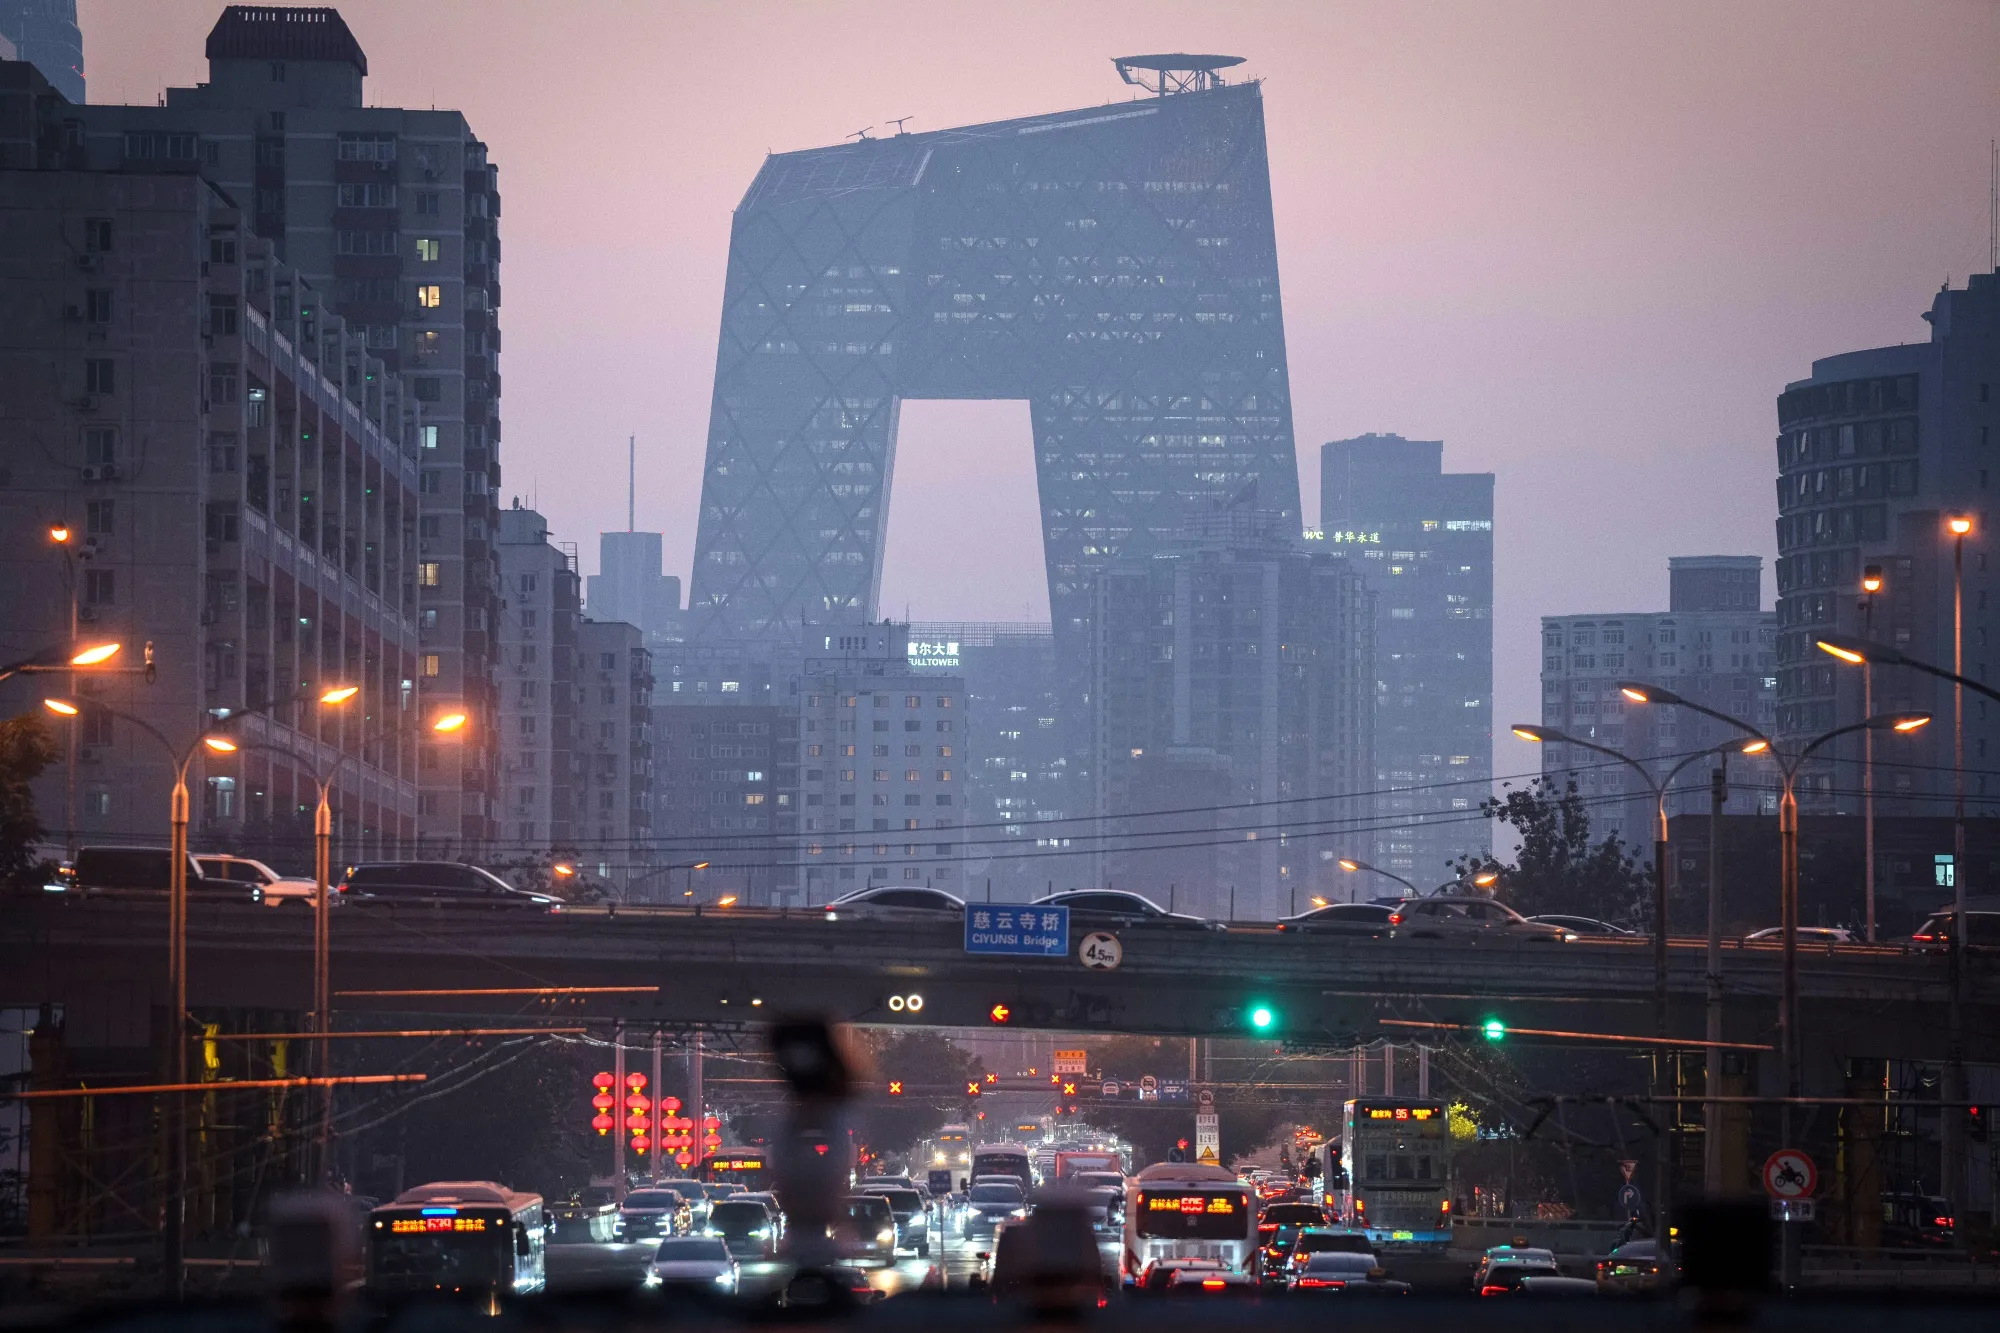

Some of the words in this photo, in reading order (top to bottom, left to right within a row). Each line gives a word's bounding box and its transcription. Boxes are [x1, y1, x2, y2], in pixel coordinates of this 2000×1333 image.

[1333, 531, 1381, 543] 普华永道
[908, 642, 960, 655] 富尔大厦
[973, 911, 1059, 931] 慈云寺桥
[972, 933, 1018, 945] CIYUNSI
[1023, 933, 1059, 948] Bridge
[1086, 943, 1114, 963] 4.5m
[1395, 1108, 1407, 1119] 95
